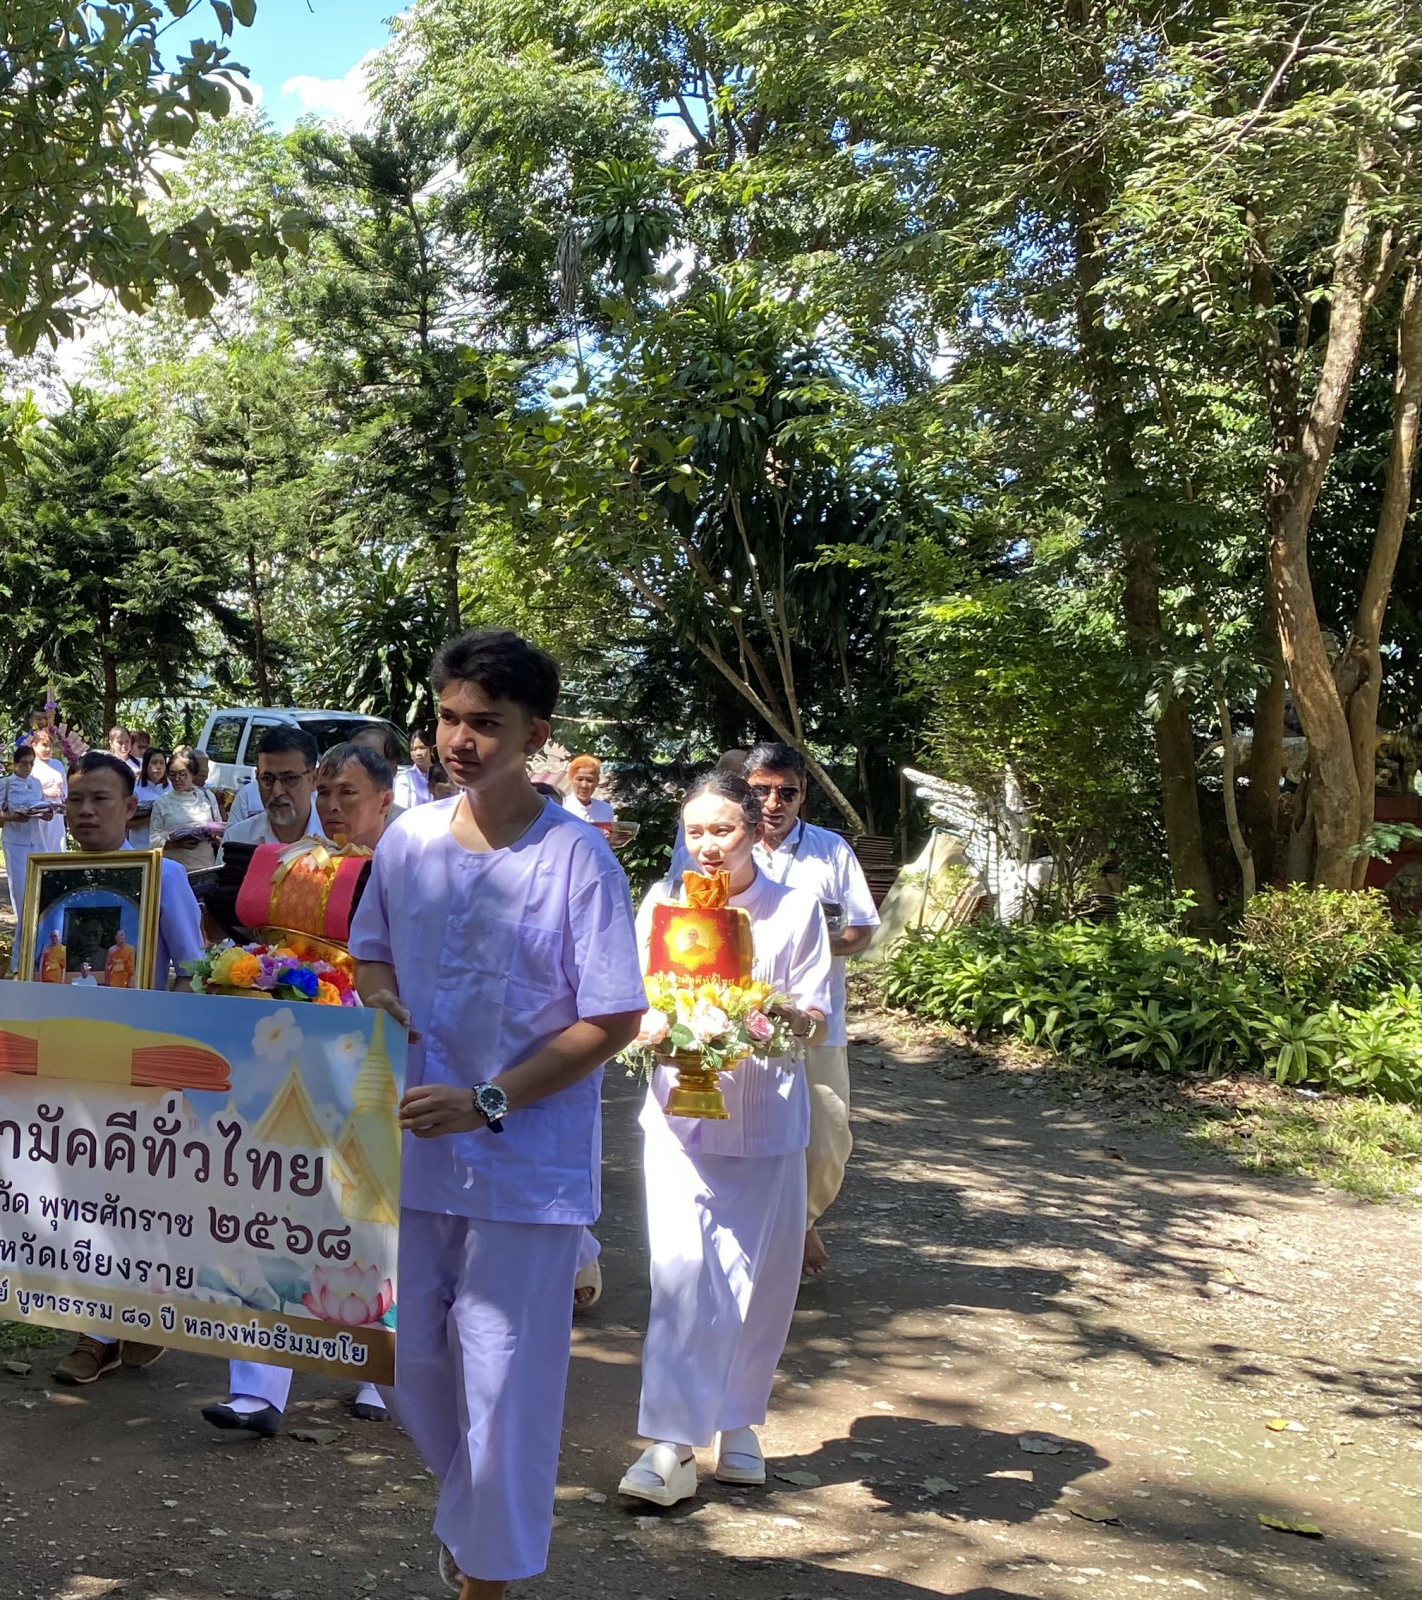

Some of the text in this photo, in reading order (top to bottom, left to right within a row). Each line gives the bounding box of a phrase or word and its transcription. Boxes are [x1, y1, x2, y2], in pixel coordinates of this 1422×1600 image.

[39, 1192, 194, 1238] พุทธศักราช
[208, 1206, 352, 1261] ๒๕๖๘
[16, 1289, 113, 1321] บูชาธรรม
[121, 1307, 151, 1328] ๘๑
[159, 1305, 176, 1331] ปี
[184, 1316, 367, 1363] หลวงพ่อธัมมชโย
